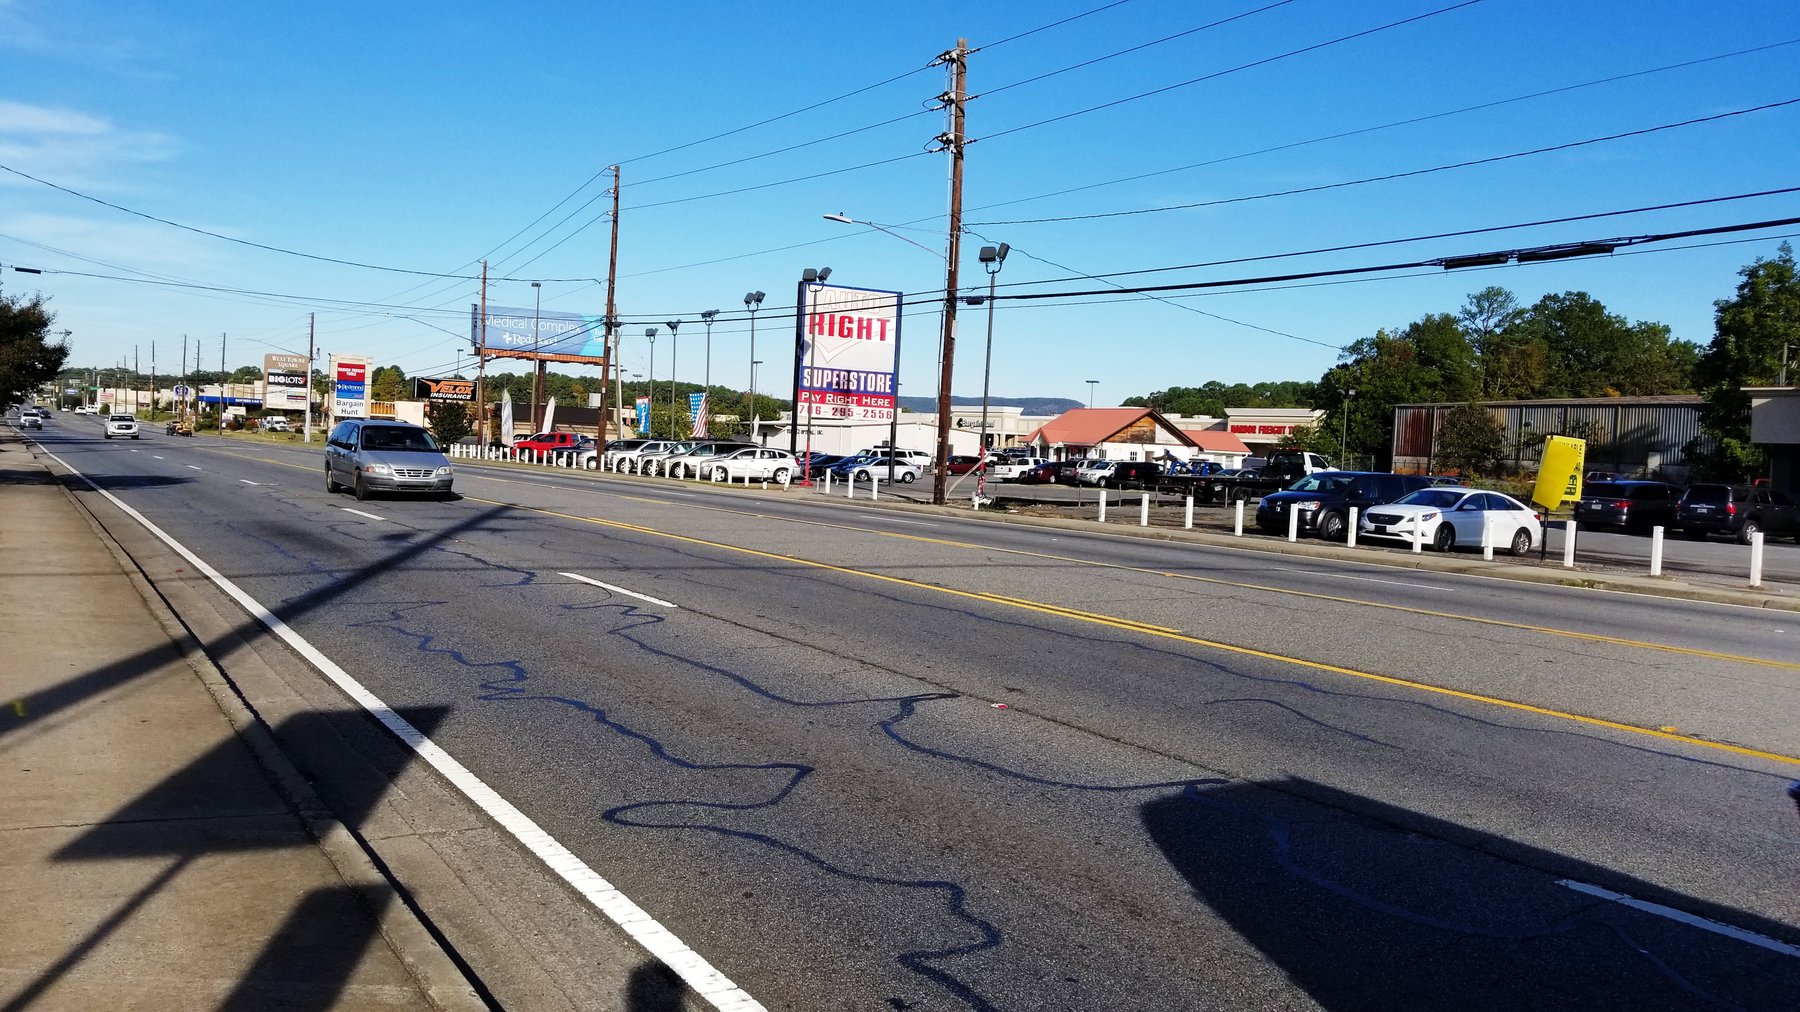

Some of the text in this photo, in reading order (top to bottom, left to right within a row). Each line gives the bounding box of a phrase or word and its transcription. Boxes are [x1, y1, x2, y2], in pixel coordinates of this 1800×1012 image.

[485, 314, 581, 333] Medical Complex
[809, 312, 890, 341] RIGHT
[419, 379, 475, 394] VELOX
[803, 368, 892, 393] SUPERSTORE
[336, 399, 364, 408] Bargain
[430, 392, 472, 400] INSURANCE
